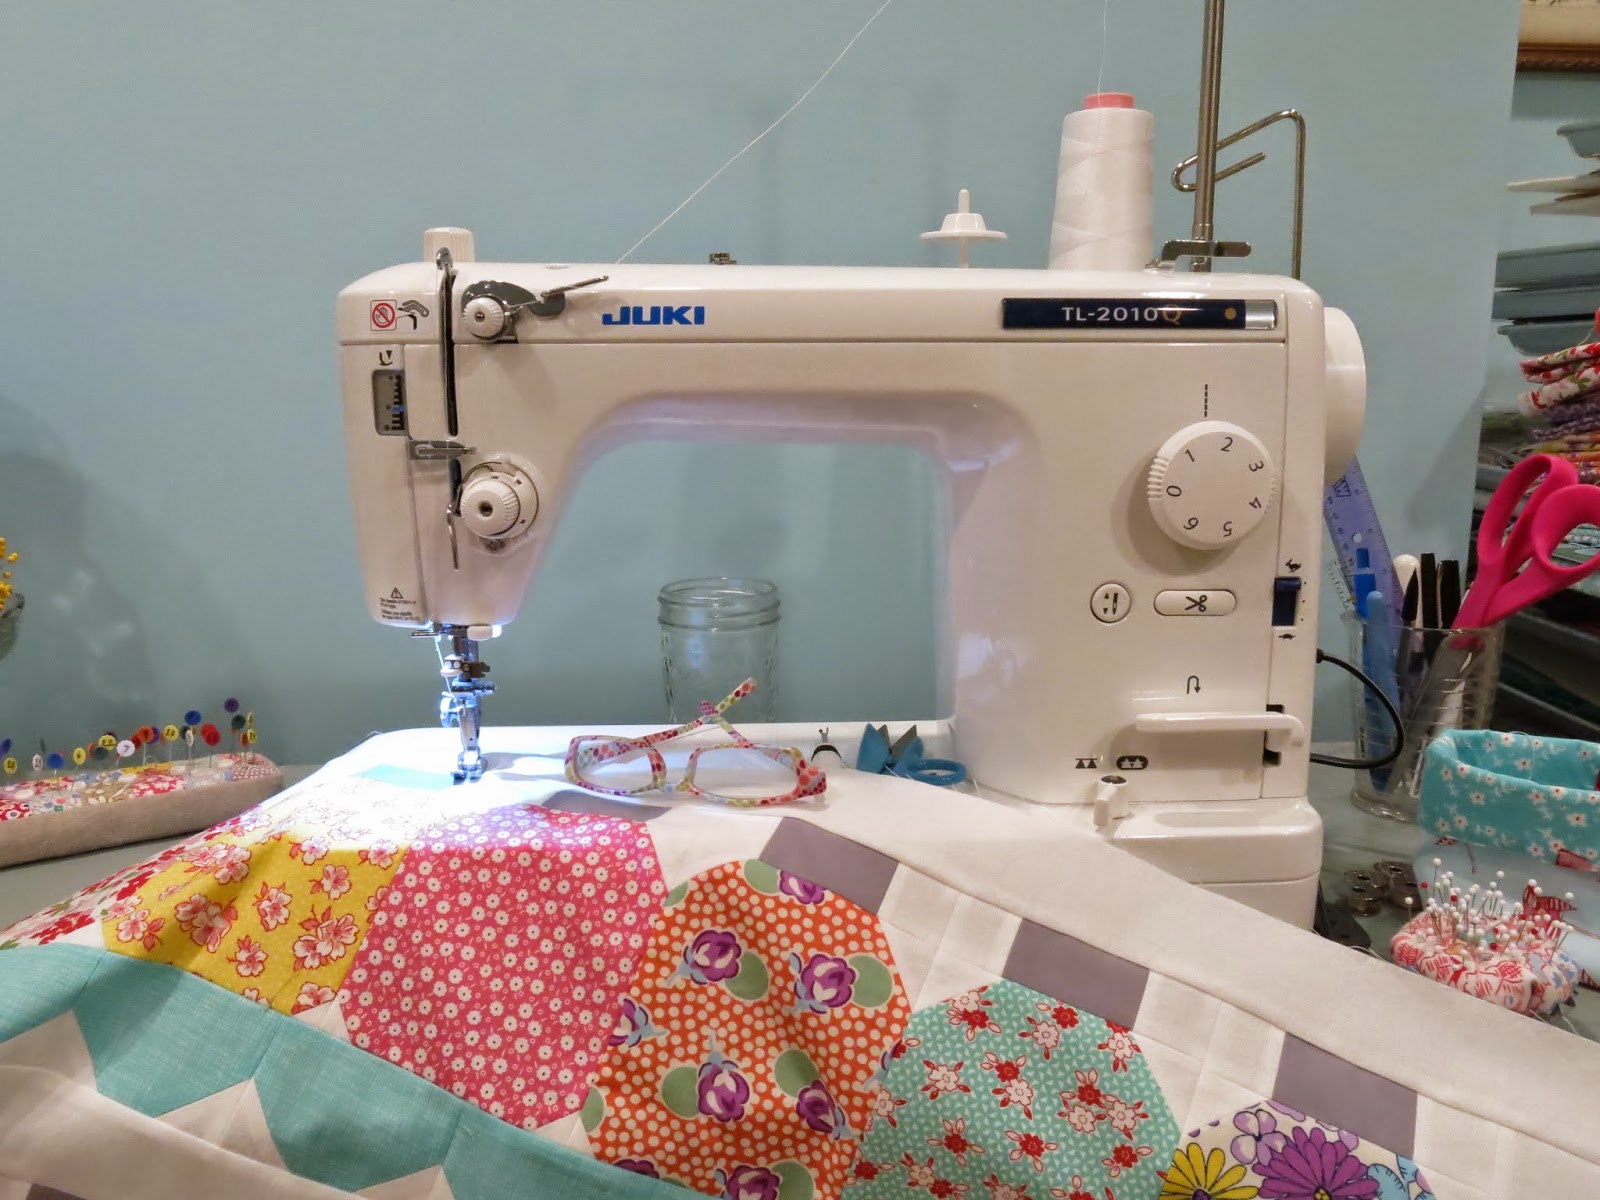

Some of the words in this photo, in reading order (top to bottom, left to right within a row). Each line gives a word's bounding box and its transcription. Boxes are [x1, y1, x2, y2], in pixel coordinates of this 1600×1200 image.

[602, 306, 705, 325] JUKI
[1061, 304, 1182, 325] TL-2010Q
[1220, 436, 1233, 452] 2
[1185, 449, 1195, 462] 1
[1248, 460, 1264, 472] 3
[1166, 485, 1182, 497] 0
[1248, 497, 1262, 509] 4
[1183, 517, 1199, 530] 6
[1223, 521, 1233, 537] 5
